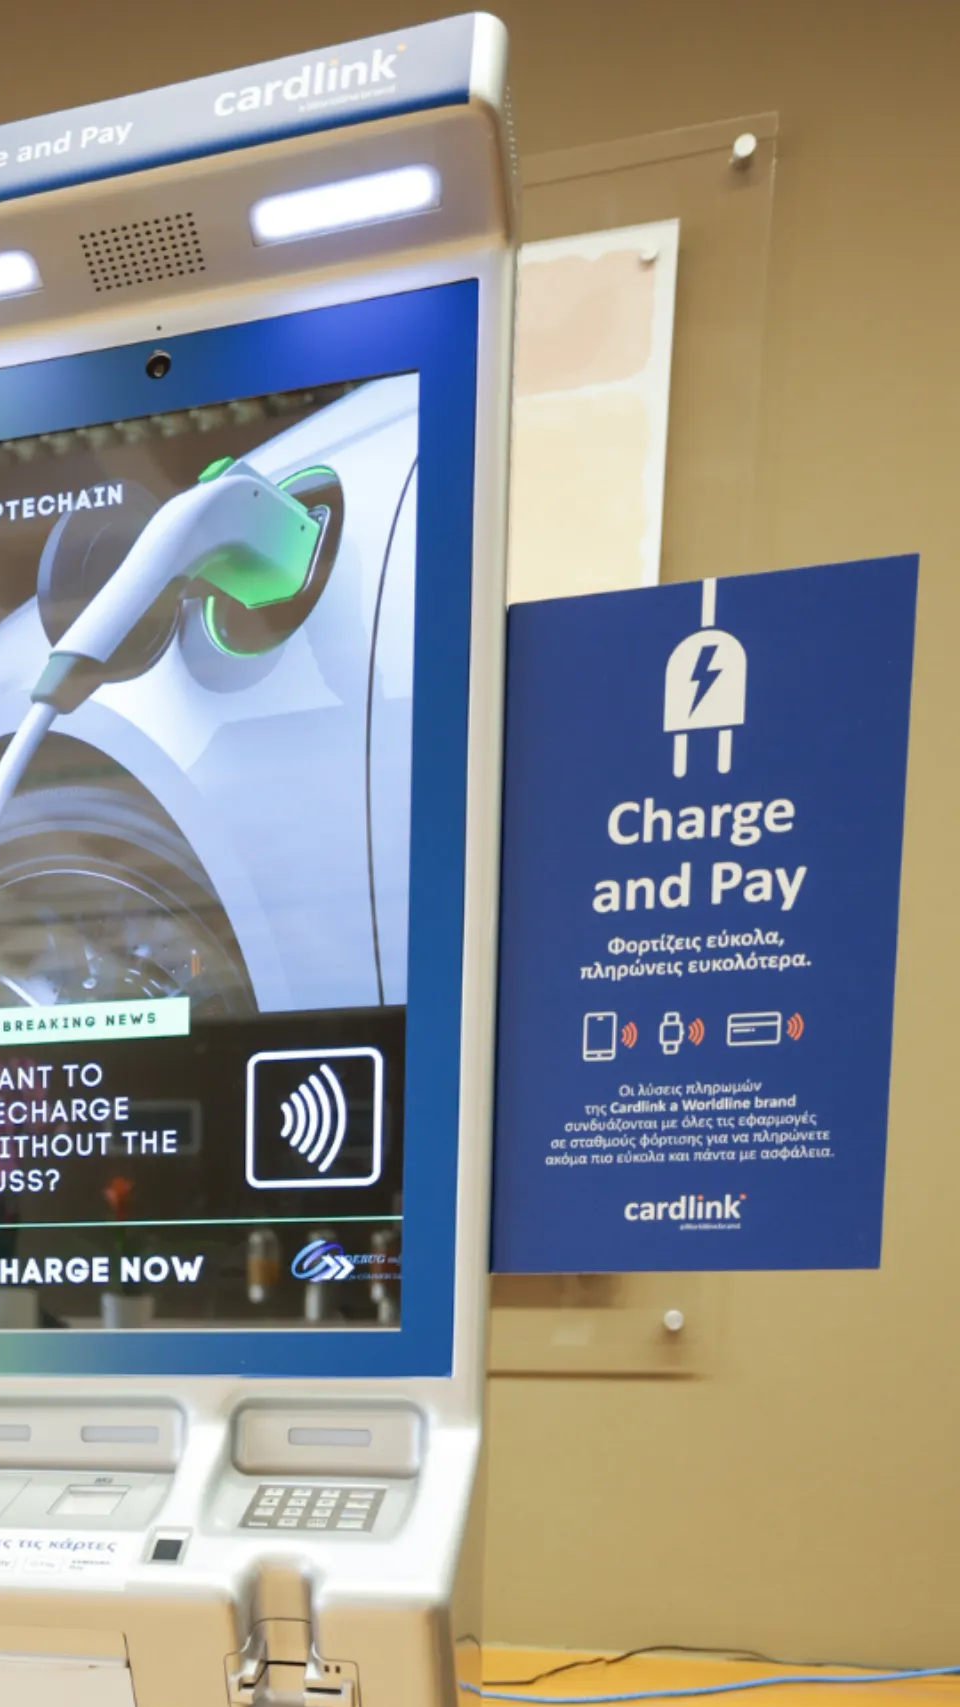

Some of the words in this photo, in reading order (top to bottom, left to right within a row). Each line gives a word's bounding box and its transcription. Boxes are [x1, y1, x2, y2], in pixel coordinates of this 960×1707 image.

[215, 49, 396, 116] cardlink
[16, 130, 73, 163] and
[79, 121, 134, 154] Pay
[607, 797, 796, 847] Charge
[591, 861, 692, 914] and
[710, 860, 808, 912] Pay
[608, 934, 701, 956] Φορτίζεις
[706, 928, 784, 948] εύκολα,
[581, 954, 682, 981] πληρώνεις
[688, 951, 811, 973] ευκολότερα.
[2, 1016, 96, 1033] BREAKING
[105, 1012, 156, 1027] NEWS
[63, 1064, 102, 1087] TO
[619, 1085, 634, 1097] Οι
[638, 1083, 682, 1097] λύσεις
[686, 1079, 762, 1096] πληρωμών
[585, 1105, 606, 1116] της
[610, 1100, 666, 1113] Cardlink
[670, 1102, 678, 1112] a
[682, 1097, 751, 1111] Worldline
[755, 1095, 796, 1108] brand
[564, 1118, 657, 1132] συνδυάζονται
[661, 1120, 677, 1131] με
[682, 1115, 713, 1129] όλες
[717, 1117, 735, 1128] τις
[738, 1111, 816, 1128] εφαρμογές
[122, 1131, 176, 1154] THE
[551, 1139, 566, 1149] σε
[570, 1134, 636, 1149] σταθμούς
[639, 1133, 703, 1148] φόρτισης
[706, 1134, 728, 1146] για
[732, 1134, 749, 1143] να
[753, 1129, 829, 1144] πληρώνετε
[545, 1152, 587, 1166] ακόμα
[591, 1154, 613, 1164] πιο
[617, 1150, 665, 1163] εύκολα
[669, 1152, 689, 1161] και
[694, 1149, 735, 1161] πάντα
[740, 1150, 756, 1162] με
[623, 1194, 742, 1221] cardlink
[121, 1256, 203, 1282] NOW
[18, 1539, 42, 1551] τις
[48, 1537, 117, 1553] κάρτες
